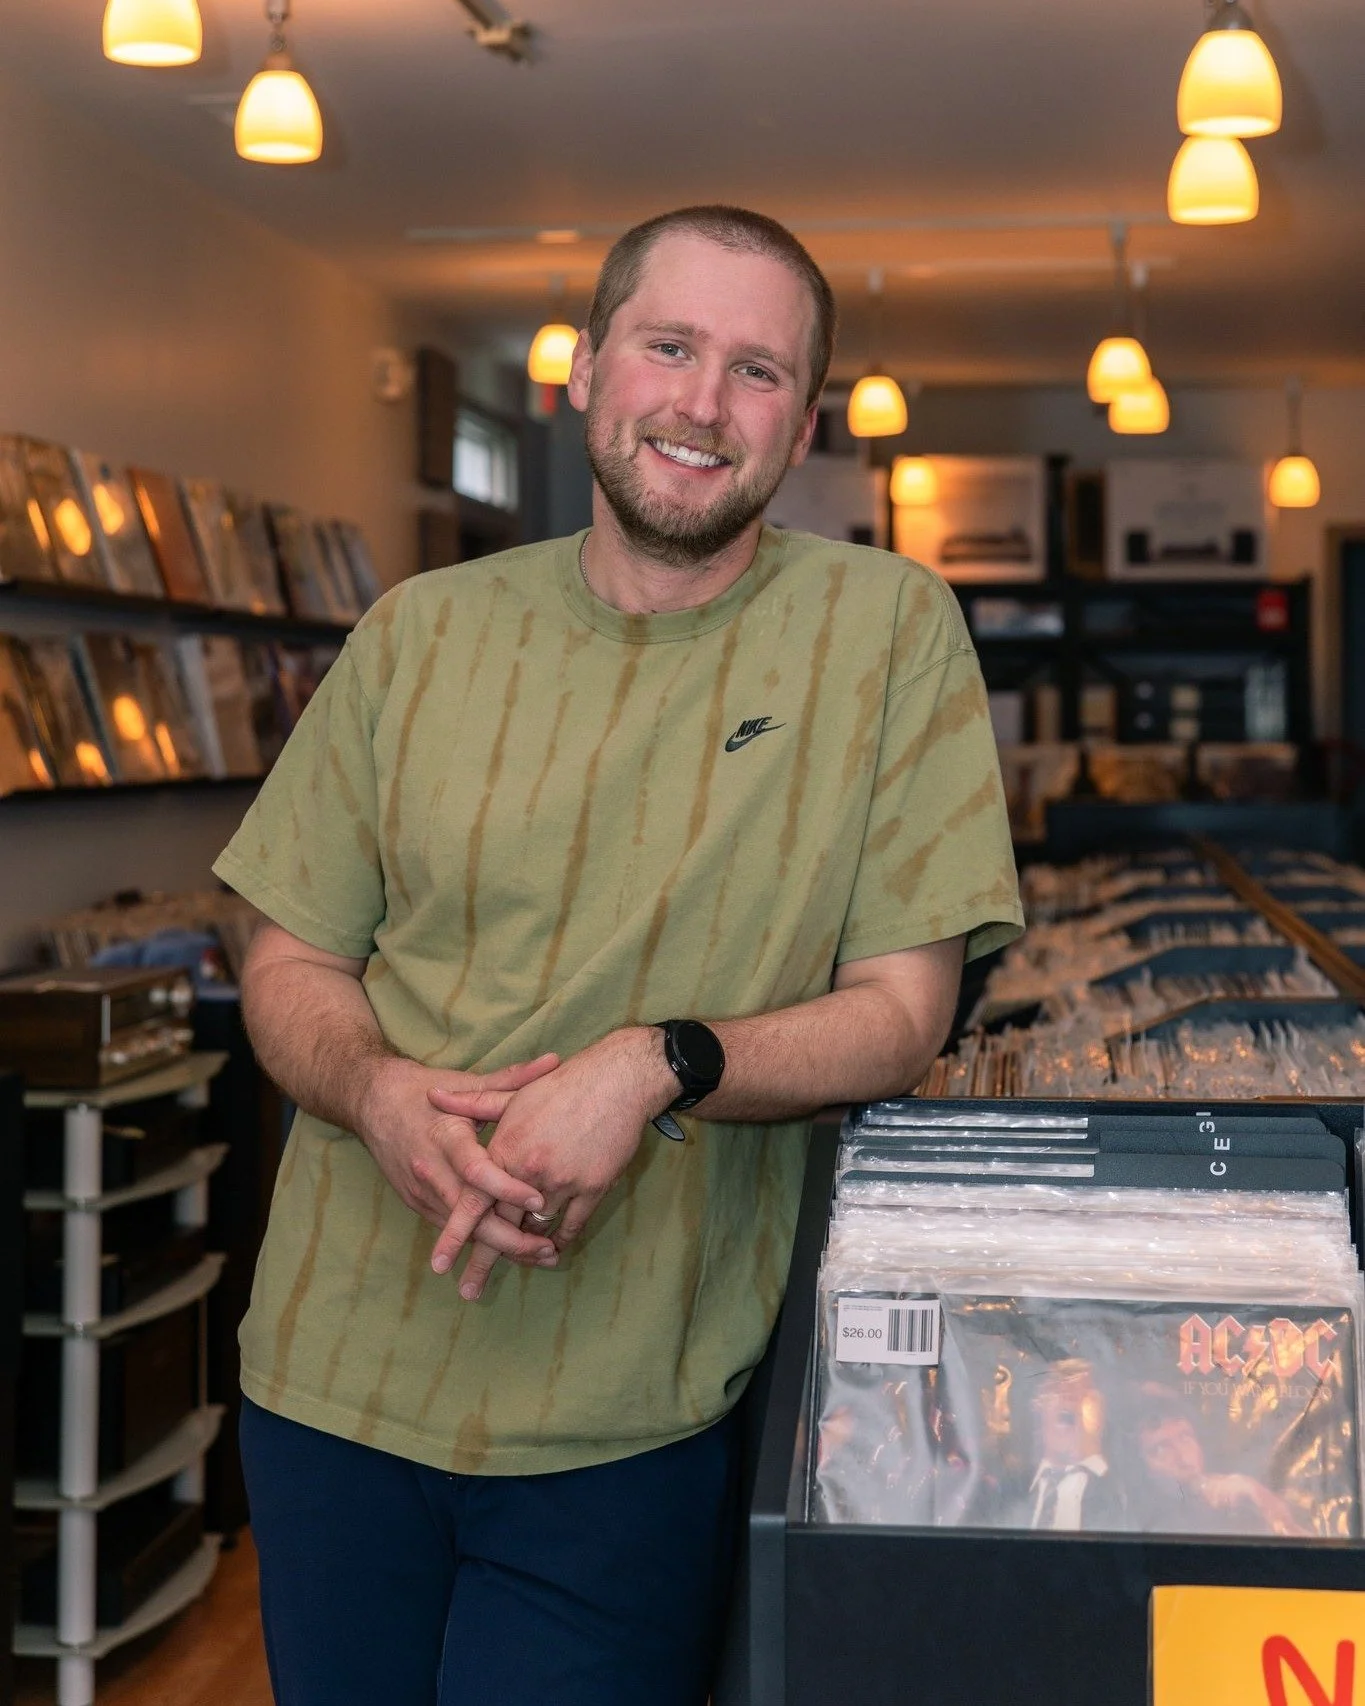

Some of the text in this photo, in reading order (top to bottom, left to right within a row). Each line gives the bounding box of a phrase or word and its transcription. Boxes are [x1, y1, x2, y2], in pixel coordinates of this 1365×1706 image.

[1214, 1137, 1230, 1150] E
[1210, 1161, 1226, 1175] C
[842, 1326, 882, 1338] $26.00
[1199, 1382, 1228, 1396] YOU
